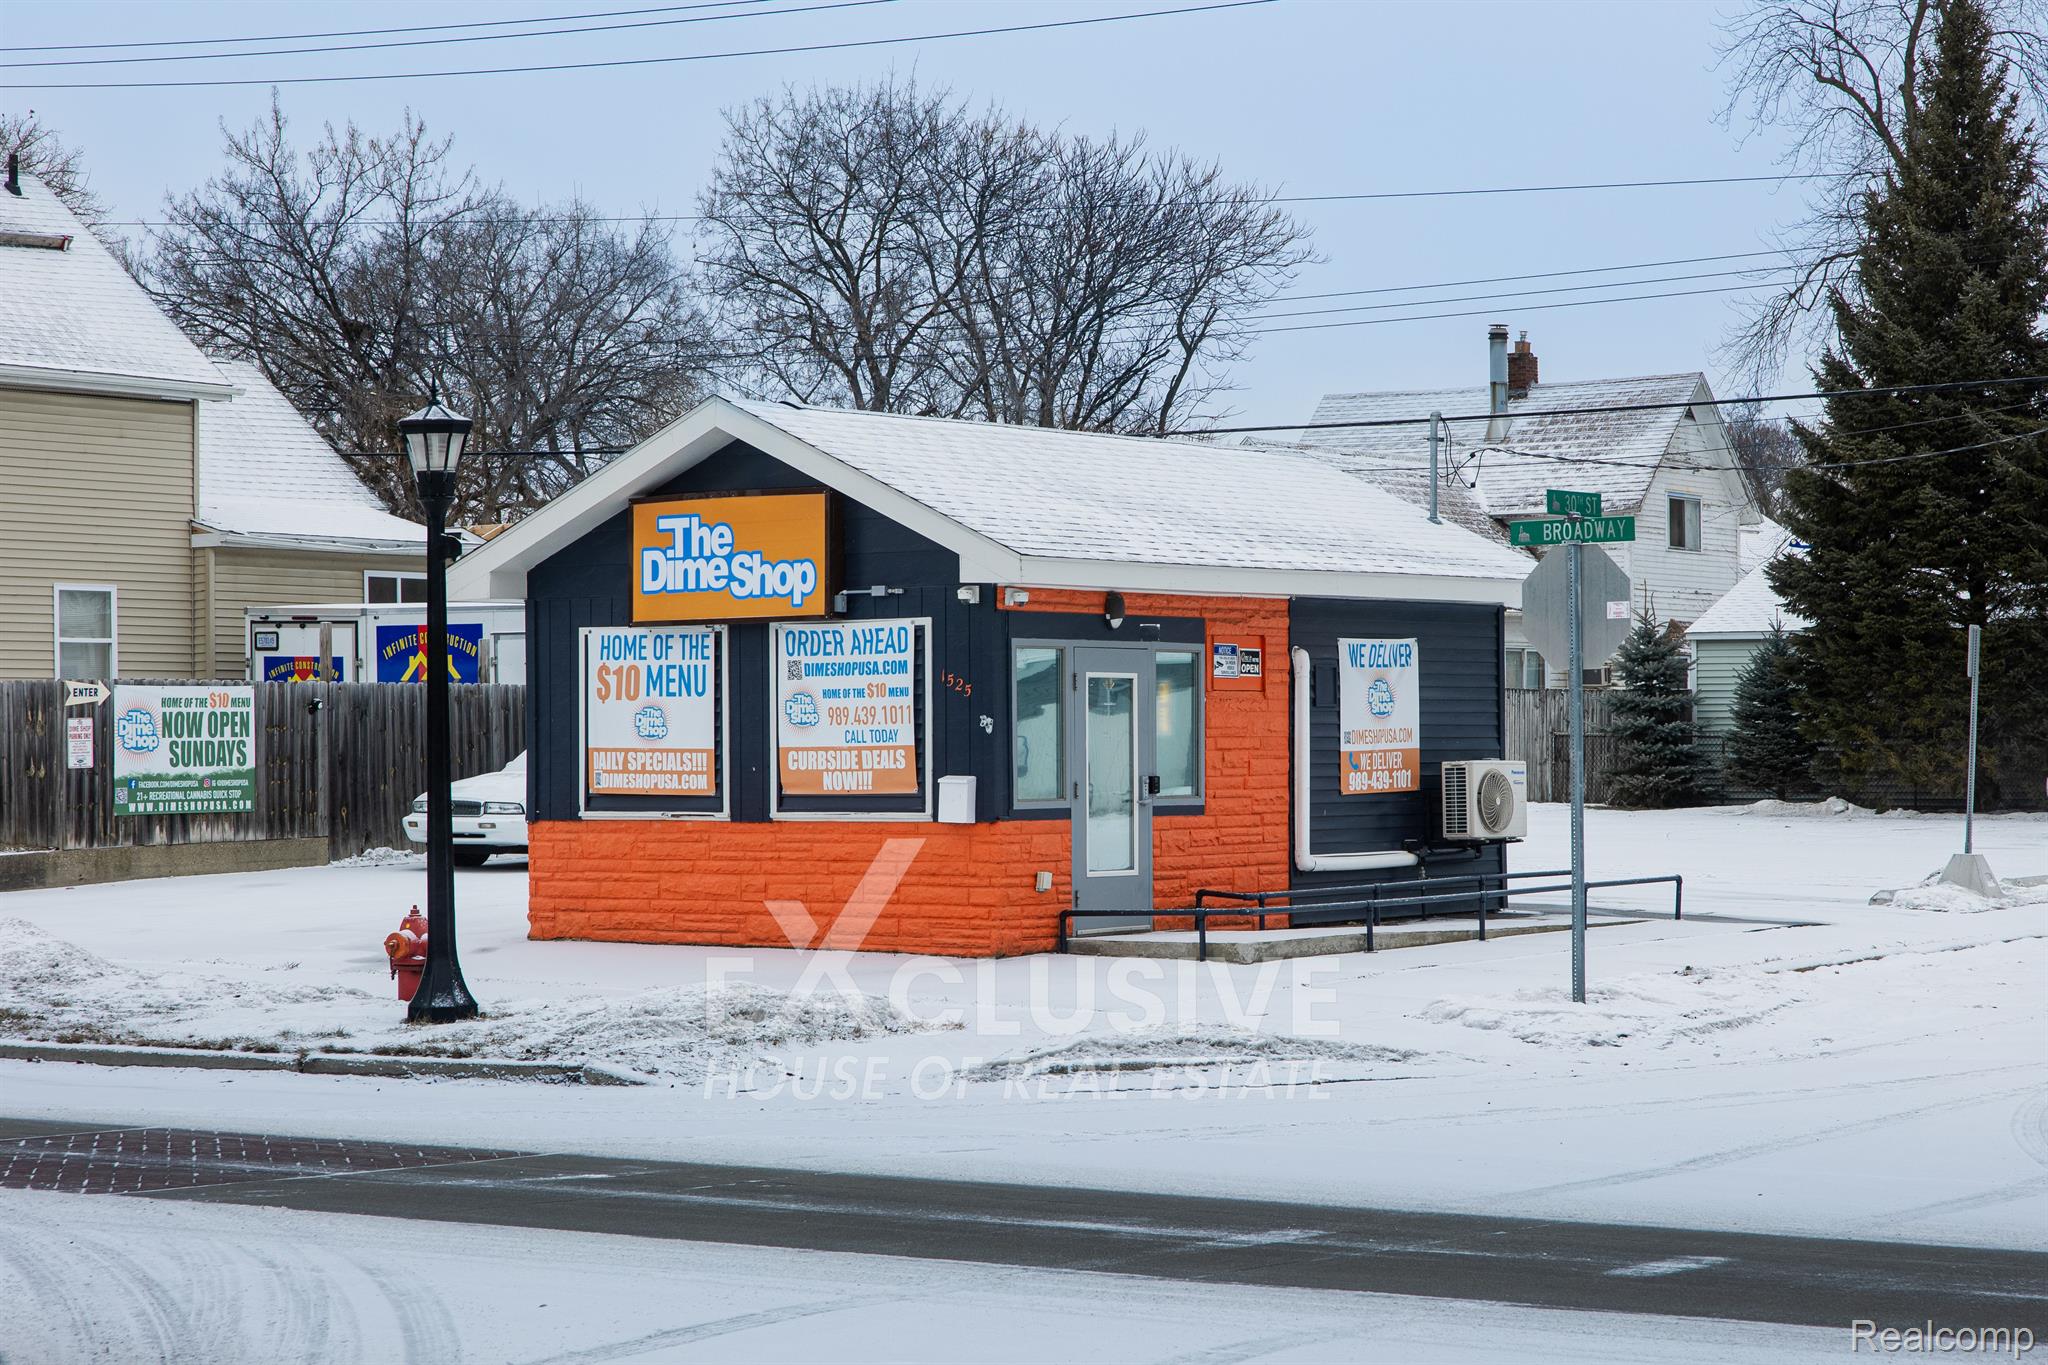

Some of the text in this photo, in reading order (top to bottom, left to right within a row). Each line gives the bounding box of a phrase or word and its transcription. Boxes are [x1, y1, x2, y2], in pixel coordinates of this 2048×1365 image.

[1586, 497, 1597, 514] ST
[657, 515, 734, 558] The
[1543, 519, 1625, 541] BROADWAY
[642, 549, 816, 606] Dime Shop
[383, 634, 417, 660] INFINITE
[600, 634, 710, 660] HOME OF THE
[785, 627, 908, 656] ORDER AHEAD
[1348, 643, 1411, 668] WE DELIVER
[268, 661, 294, 679] INFINITE
[804, 660, 908, 677] DIMESHOPUSA.COM
[1241, 664, 1259, 673] OPEN
[596, 662, 707, 704] $10 MENU
[822, 683, 909, 699] HOME OF THE $10 MENU
[941, 669, 972, 697] 1525
[73, 687, 99, 697] ENTER
[161, 692, 251, 709] HOME OF THE $10 MENU
[794, 694, 811, 705] The
[643, 708, 662, 717] The
[786, 700, 815, 714] Dime
[828, 705, 912, 726] 989.439.1011
[127, 711, 151, 725] The
[162, 711, 250, 738] NOW OPEN
[635, 714, 664, 728] Dime
[790, 711, 819, 726] Shop
[118, 719, 155, 737] Dime
[640, 725, 668, 738] Shop
[845, 729, 899, 743] CALL TODAY
[1352, 728, 1413, 745] DIMESHOPUSA.COM
[124, 736, 159, 751] Shop
[169, 740, 247, 767] SUNDAYS
[593, 751, 707, 771] DAILY SPECIALS!!!
[788, 749, 906, 770] CURBSIDE DEALS
[1360, 752, 1403, 770] WE DELIVER
[602, 773, 707, 789] DIMESHOPUSA.COM
[823, 771, 873, 791] NOW!!!
[1349, 769, 1411, 791] 989-439-1101
[137, 789, 241, 801] 21+ RECREATIONAL CANNABIS QUICK STOP
[129, 800, 252, 813] WWW.DIMESHOPUSA.COM
